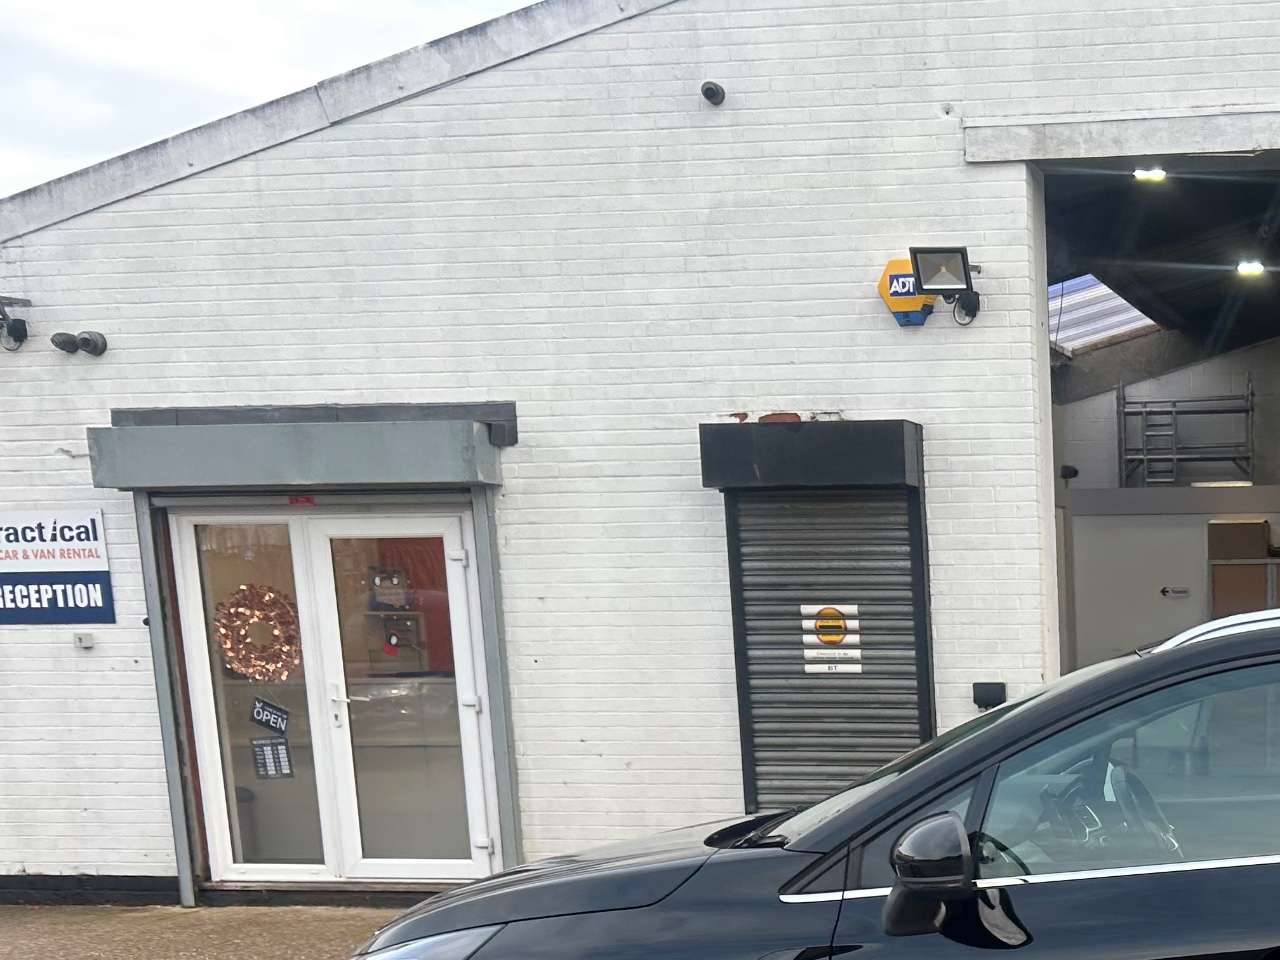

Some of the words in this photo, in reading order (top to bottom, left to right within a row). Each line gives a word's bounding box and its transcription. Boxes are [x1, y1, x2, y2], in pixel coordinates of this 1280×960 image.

[890, 277, 915, 294] ADT
[0, 518, 98, 543] actical
[22, 549, 30, 560] &
[32, 548, 56, 559] VAN
[59, 547, 101, 559] RENTAL
[253, 708, 287, 730] OPEN
